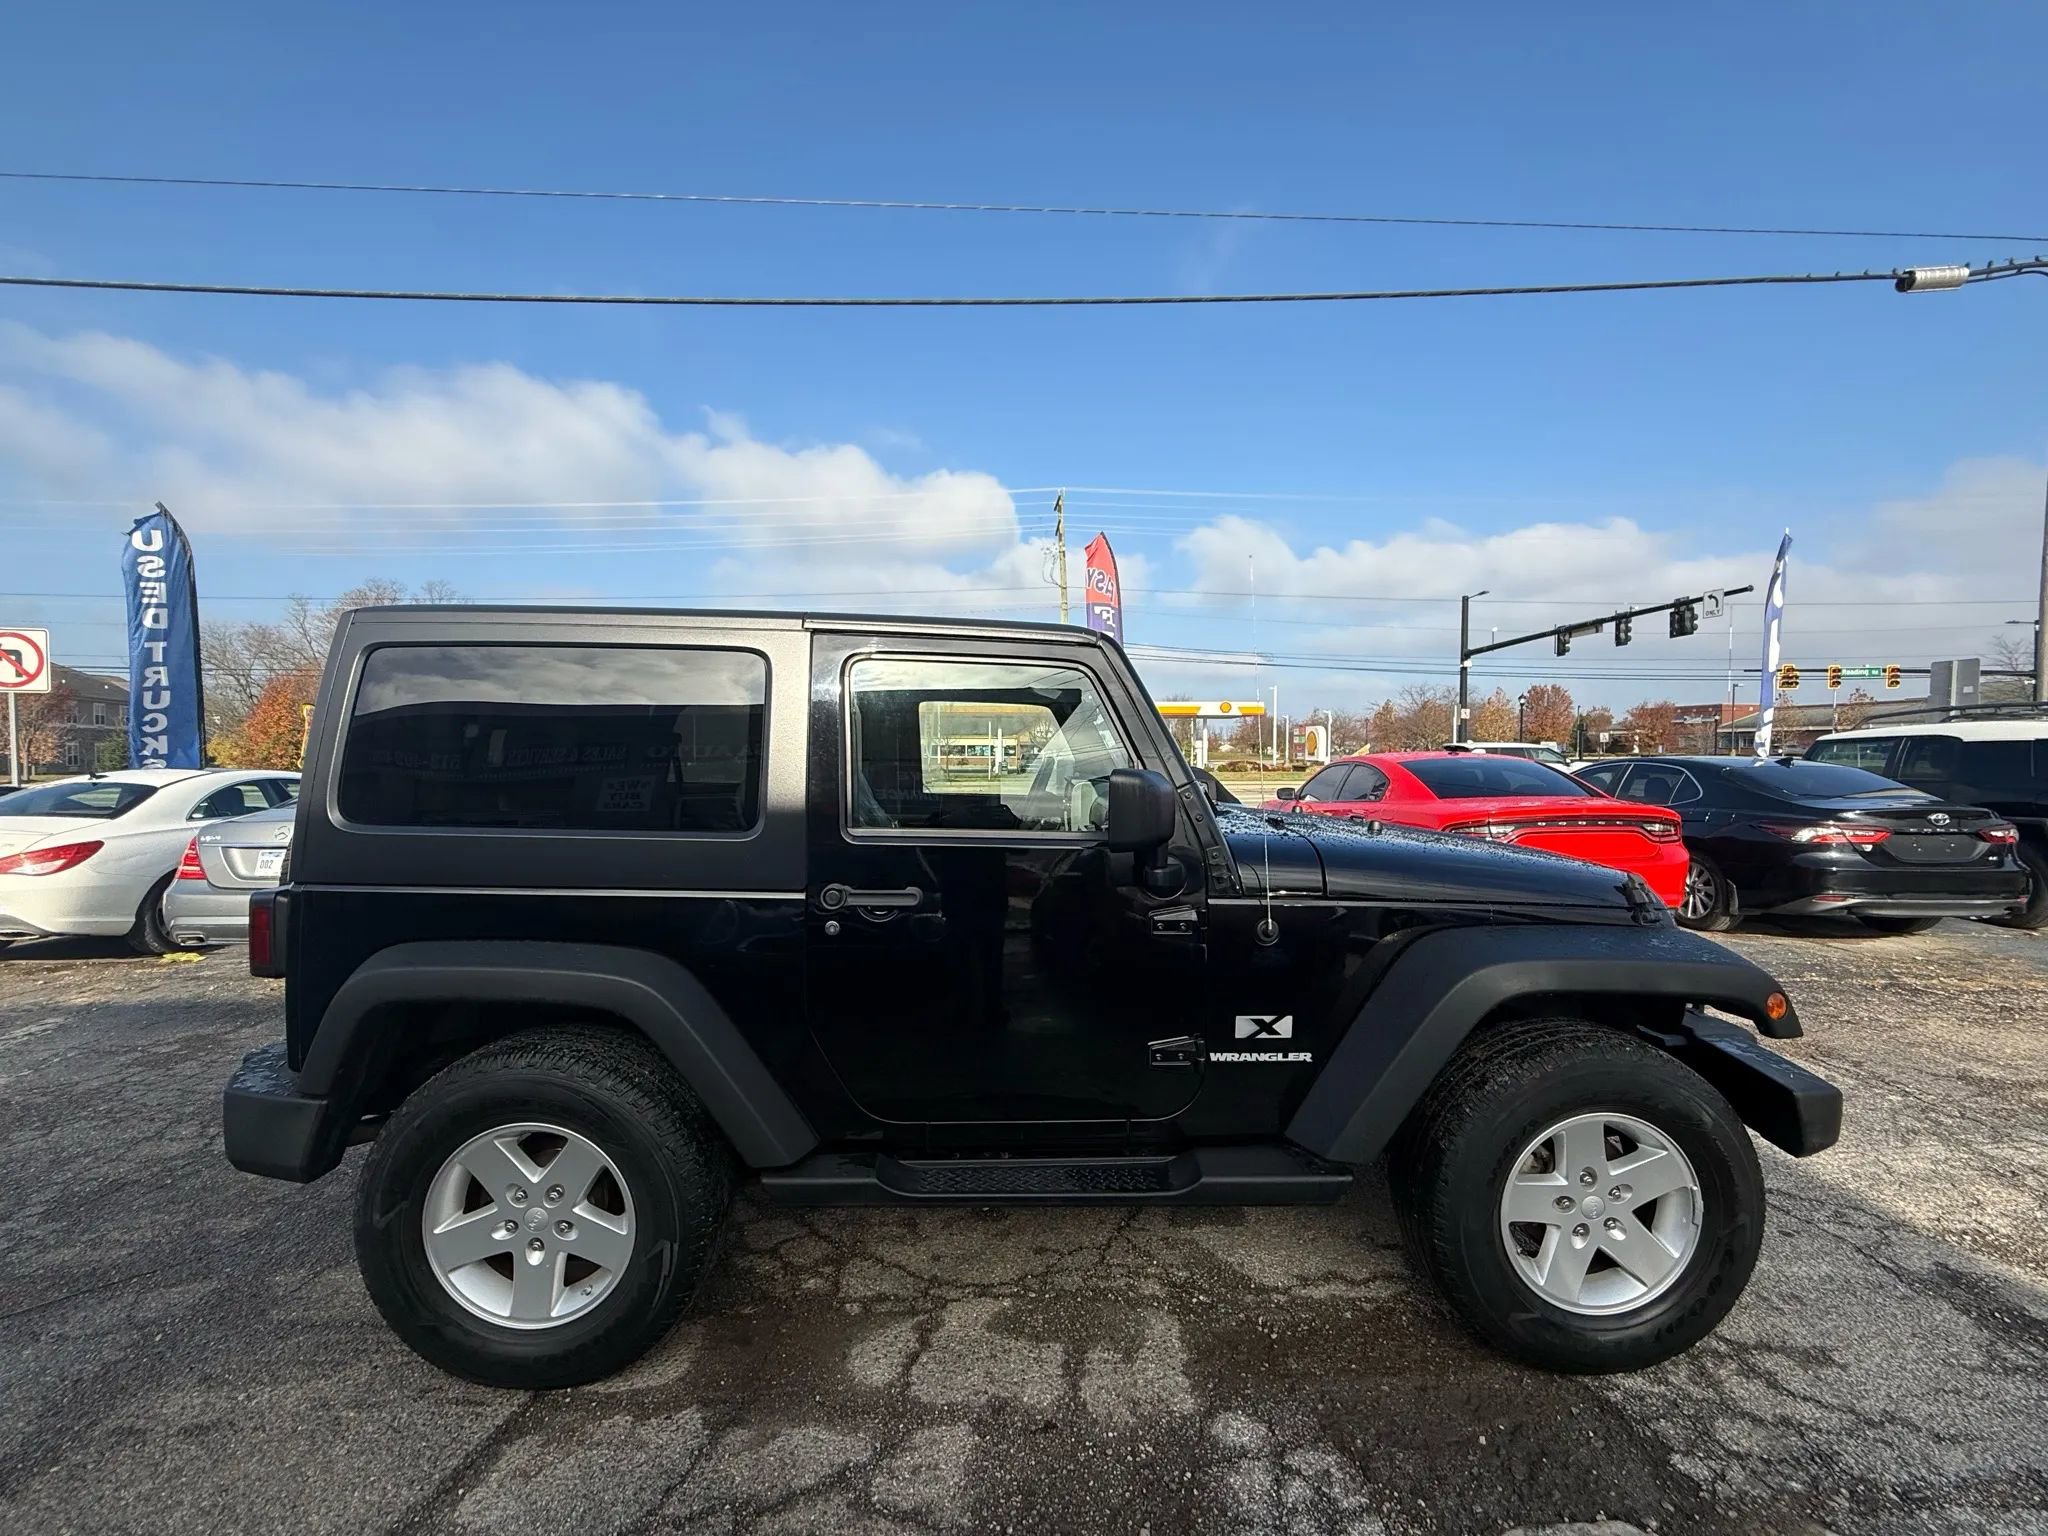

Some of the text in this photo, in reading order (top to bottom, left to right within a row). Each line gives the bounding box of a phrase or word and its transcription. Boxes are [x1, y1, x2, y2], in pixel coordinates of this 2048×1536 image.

[1705, 609, 1720, 617] ONLY
[1841, 668, 1869, 676] Reading
[1209, 1052, 1313, 1062] WRANGLER
